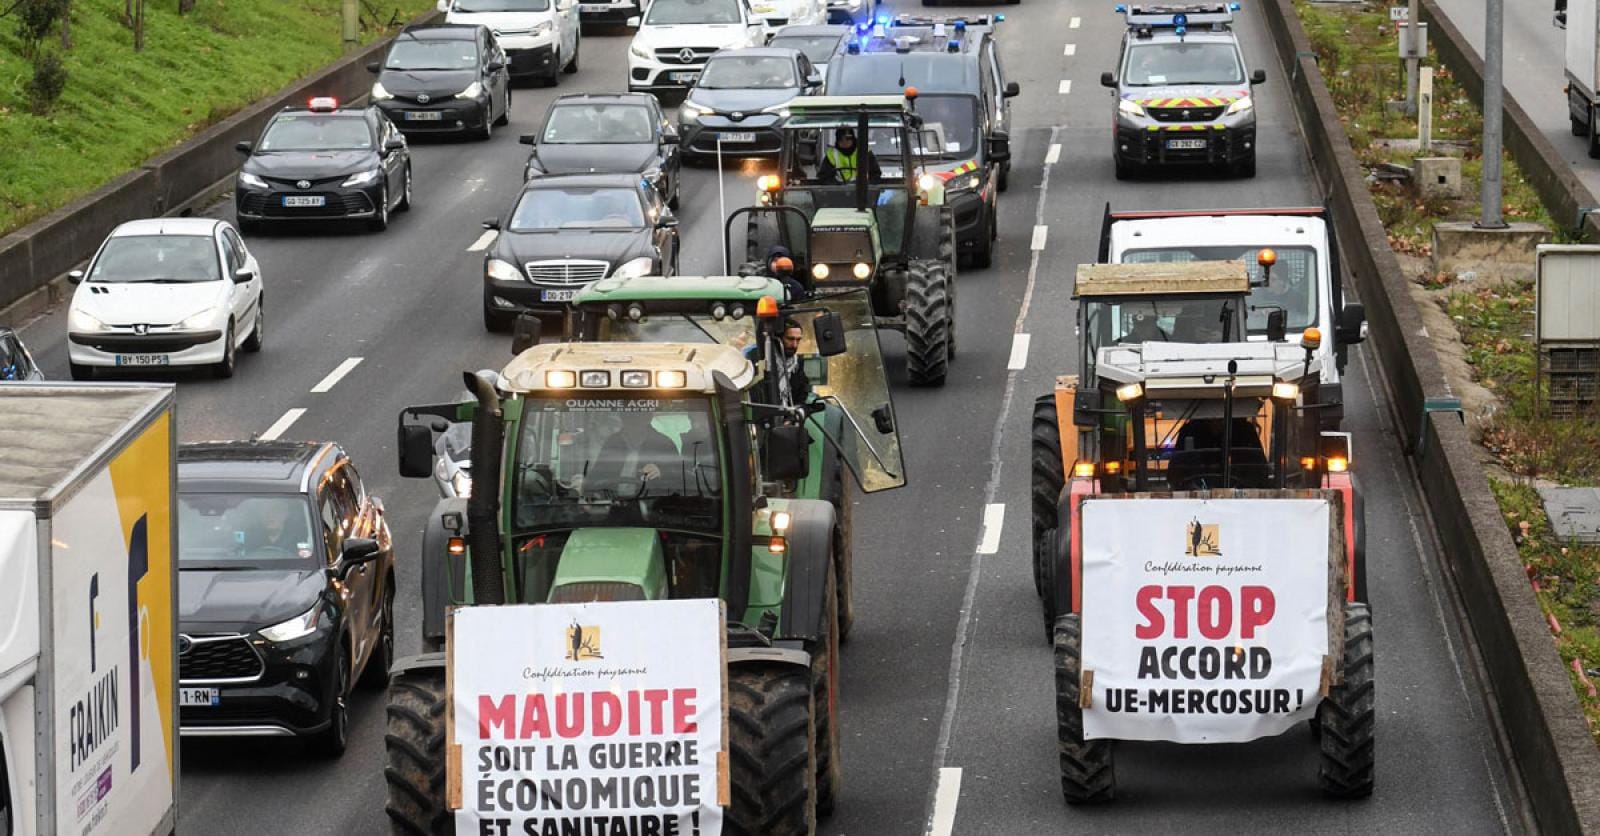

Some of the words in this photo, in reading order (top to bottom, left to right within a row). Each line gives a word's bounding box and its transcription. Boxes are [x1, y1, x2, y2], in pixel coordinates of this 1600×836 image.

[627, 399, 659, 408] AGRI
[1144, 560, 1213, 576] Confédération
[1215, 564, 1262, 576] paysanne
[1135, 584, 1276, 640] STOP
[523, 667, 594, 682] Confédération
[597, 667, 647, 680] paysanne
[1137, 645, 1272, 680] ACCORD
[478, 688, 698, 740] MAUDITE
[1105, 688, 1290, 714] UE-MERCOSUR
[70, 665, 118, 773] FRAIKIN
[478, 745, 536, 772] SOIT
[546, 744, 579, 771] LA
[589, 740, 699, 769] GUERRE
[478, 773, 700, 812] ÉCONOMIQUE
[479, 817, 511, 836] ET
[523, 813, 680, 836] SANITAIRE
